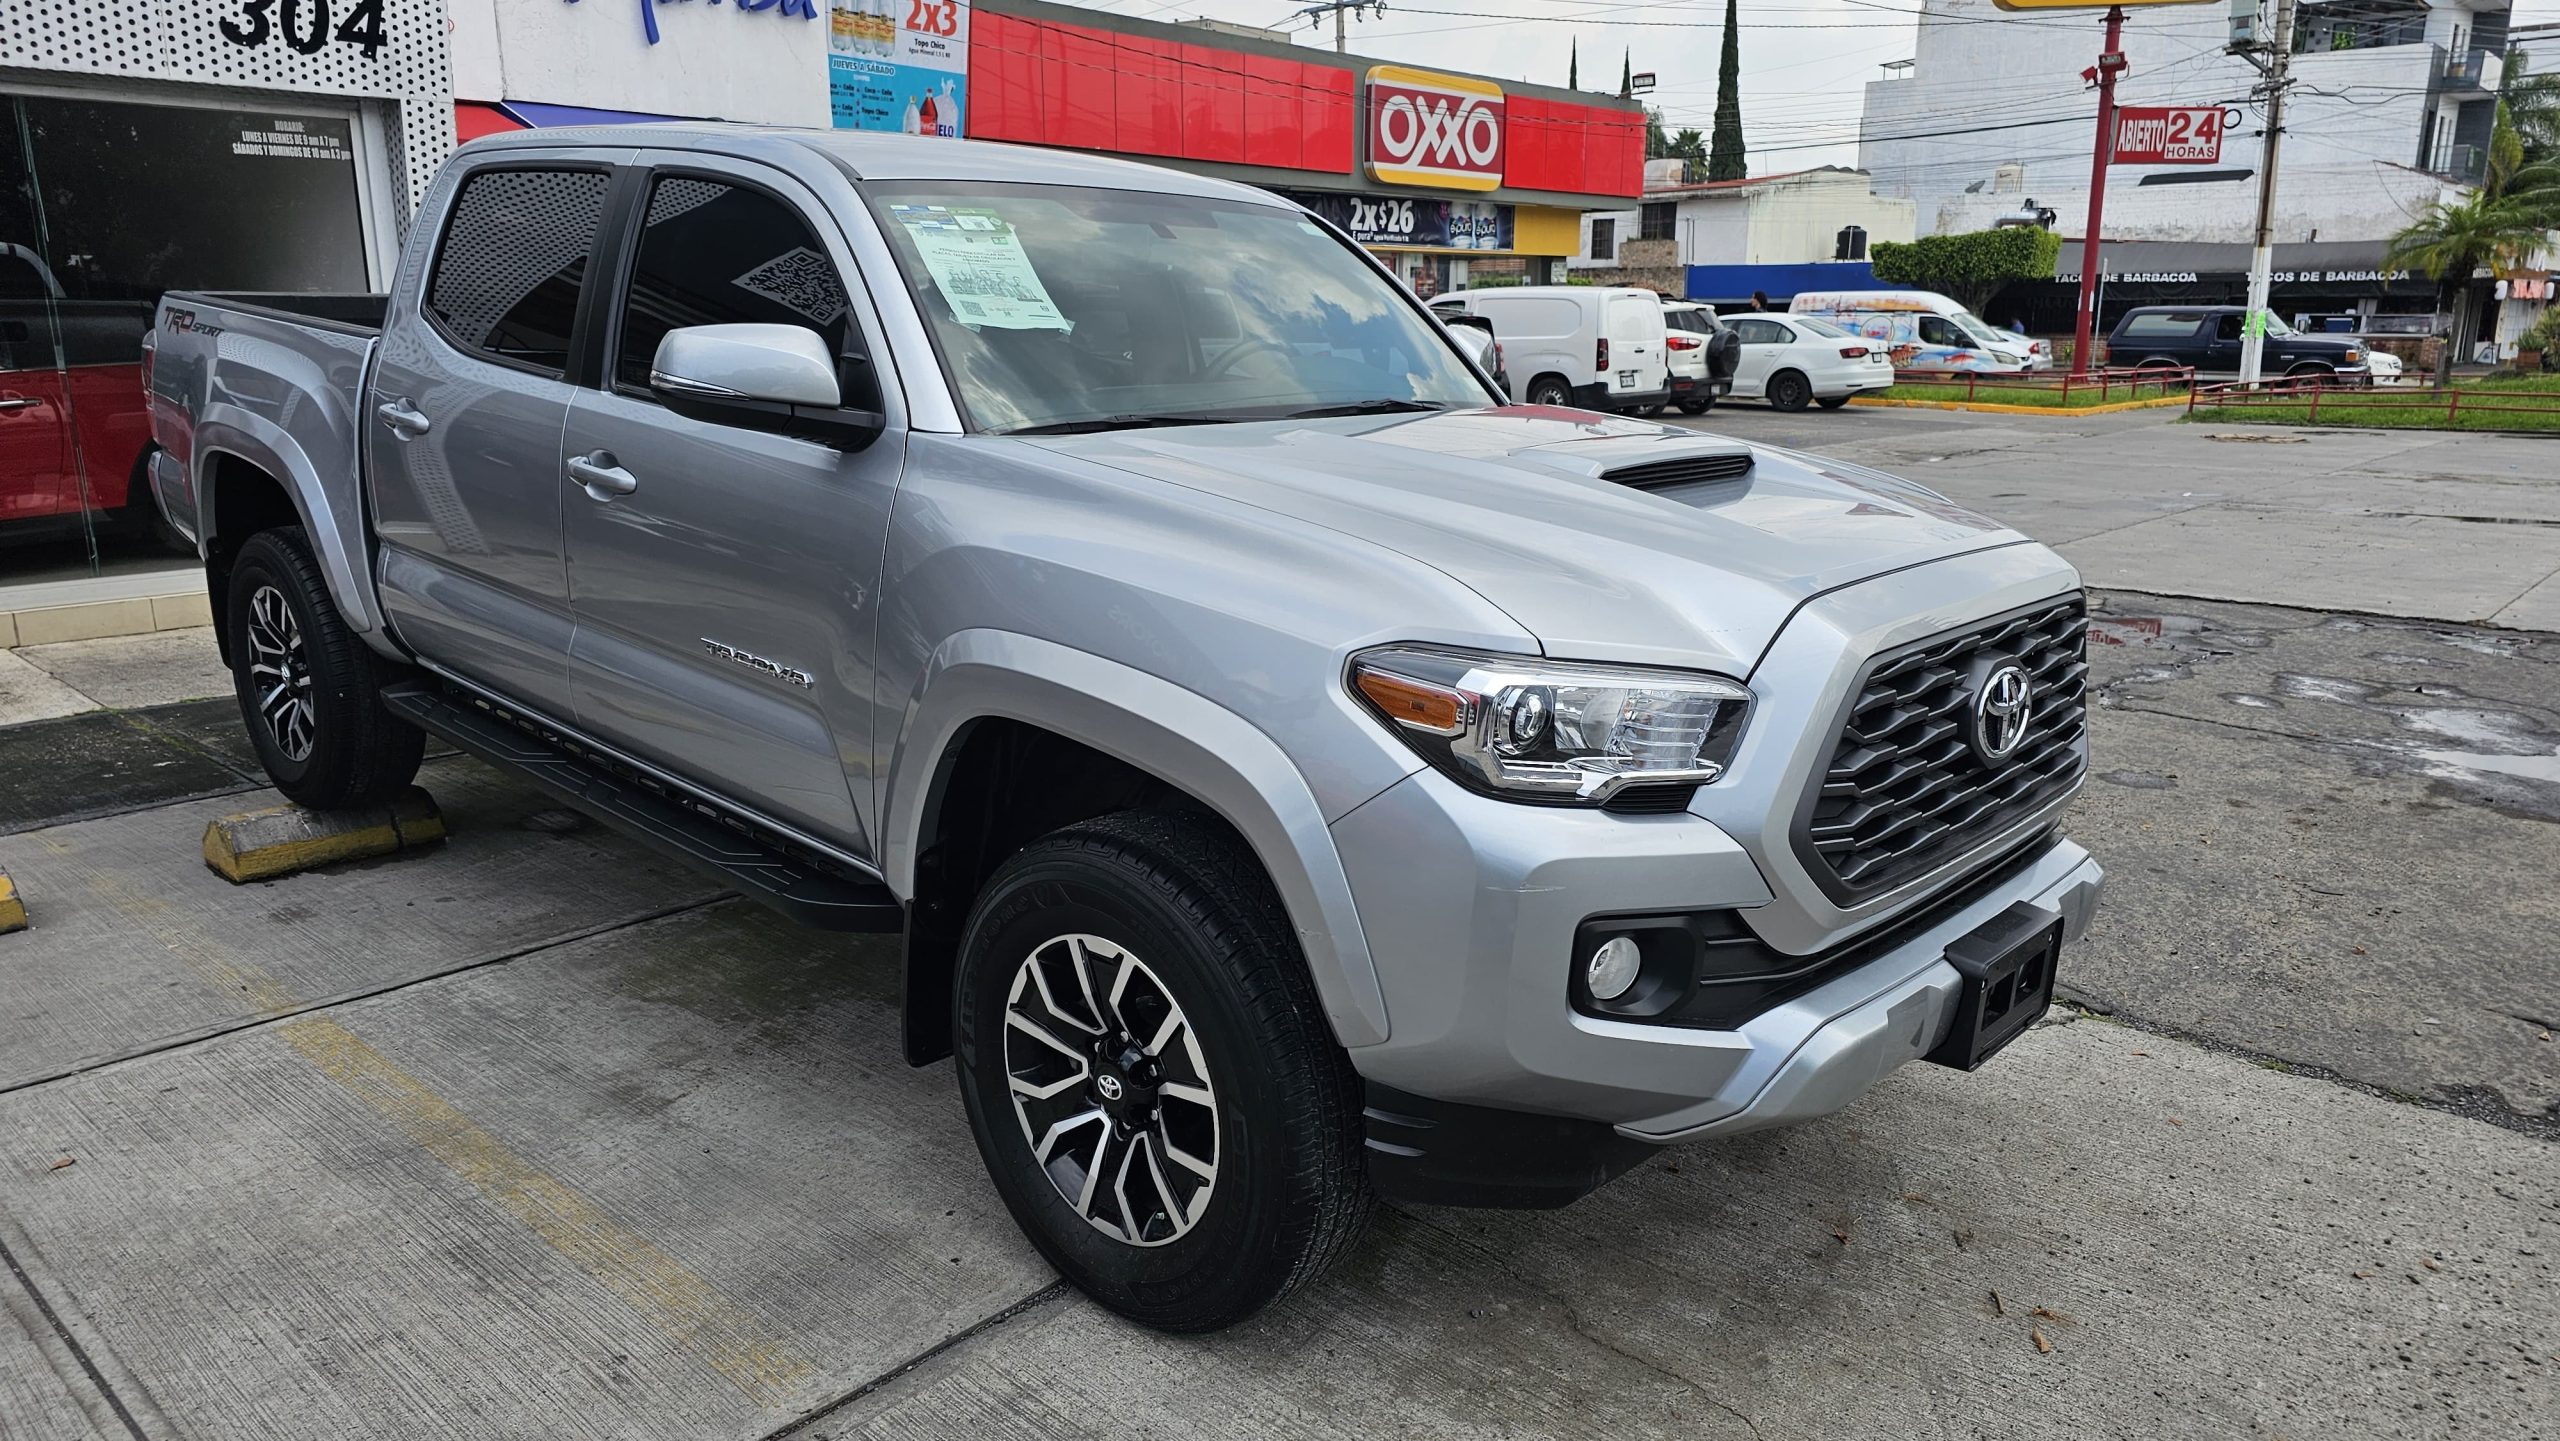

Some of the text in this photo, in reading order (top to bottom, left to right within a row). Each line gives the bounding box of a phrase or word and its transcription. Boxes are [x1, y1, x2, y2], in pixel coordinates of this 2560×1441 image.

[906, 0, 957, 37] 2x3
[219, 0, 388, 63] 304
[914, 38, 946, 50] Topo Chico
[832, 59, 895, 76] JUEVES A SÁBADO
[242, 131, 262, 143] LUNES
[262, 132, 268, 143] A
[267, 132, 294, 145] VIERNES
[294, 133, 303, 145] DE
[303, 134, 308, 145] 9
[1380, 95, 1498, 166] OXXO
[2117, 112, 2217, 152] ABIERTO 24
[232, 141, 263, 155] SÁBADOS
[269, 145, 303, 158] DOMINGOS
[303, 147, 312, 158] DE
[311, 148, 320, 158] 10
[2166, 146, 2215, 158] HORAS
[2123, 272, 2198, 283] BARBACOA
[2246, 270, 2410, 282] TCOS DE BARBACOA
[165, 306, 225, 337] TRD SPORT
[700, 637, 814, 689] TACOMA
